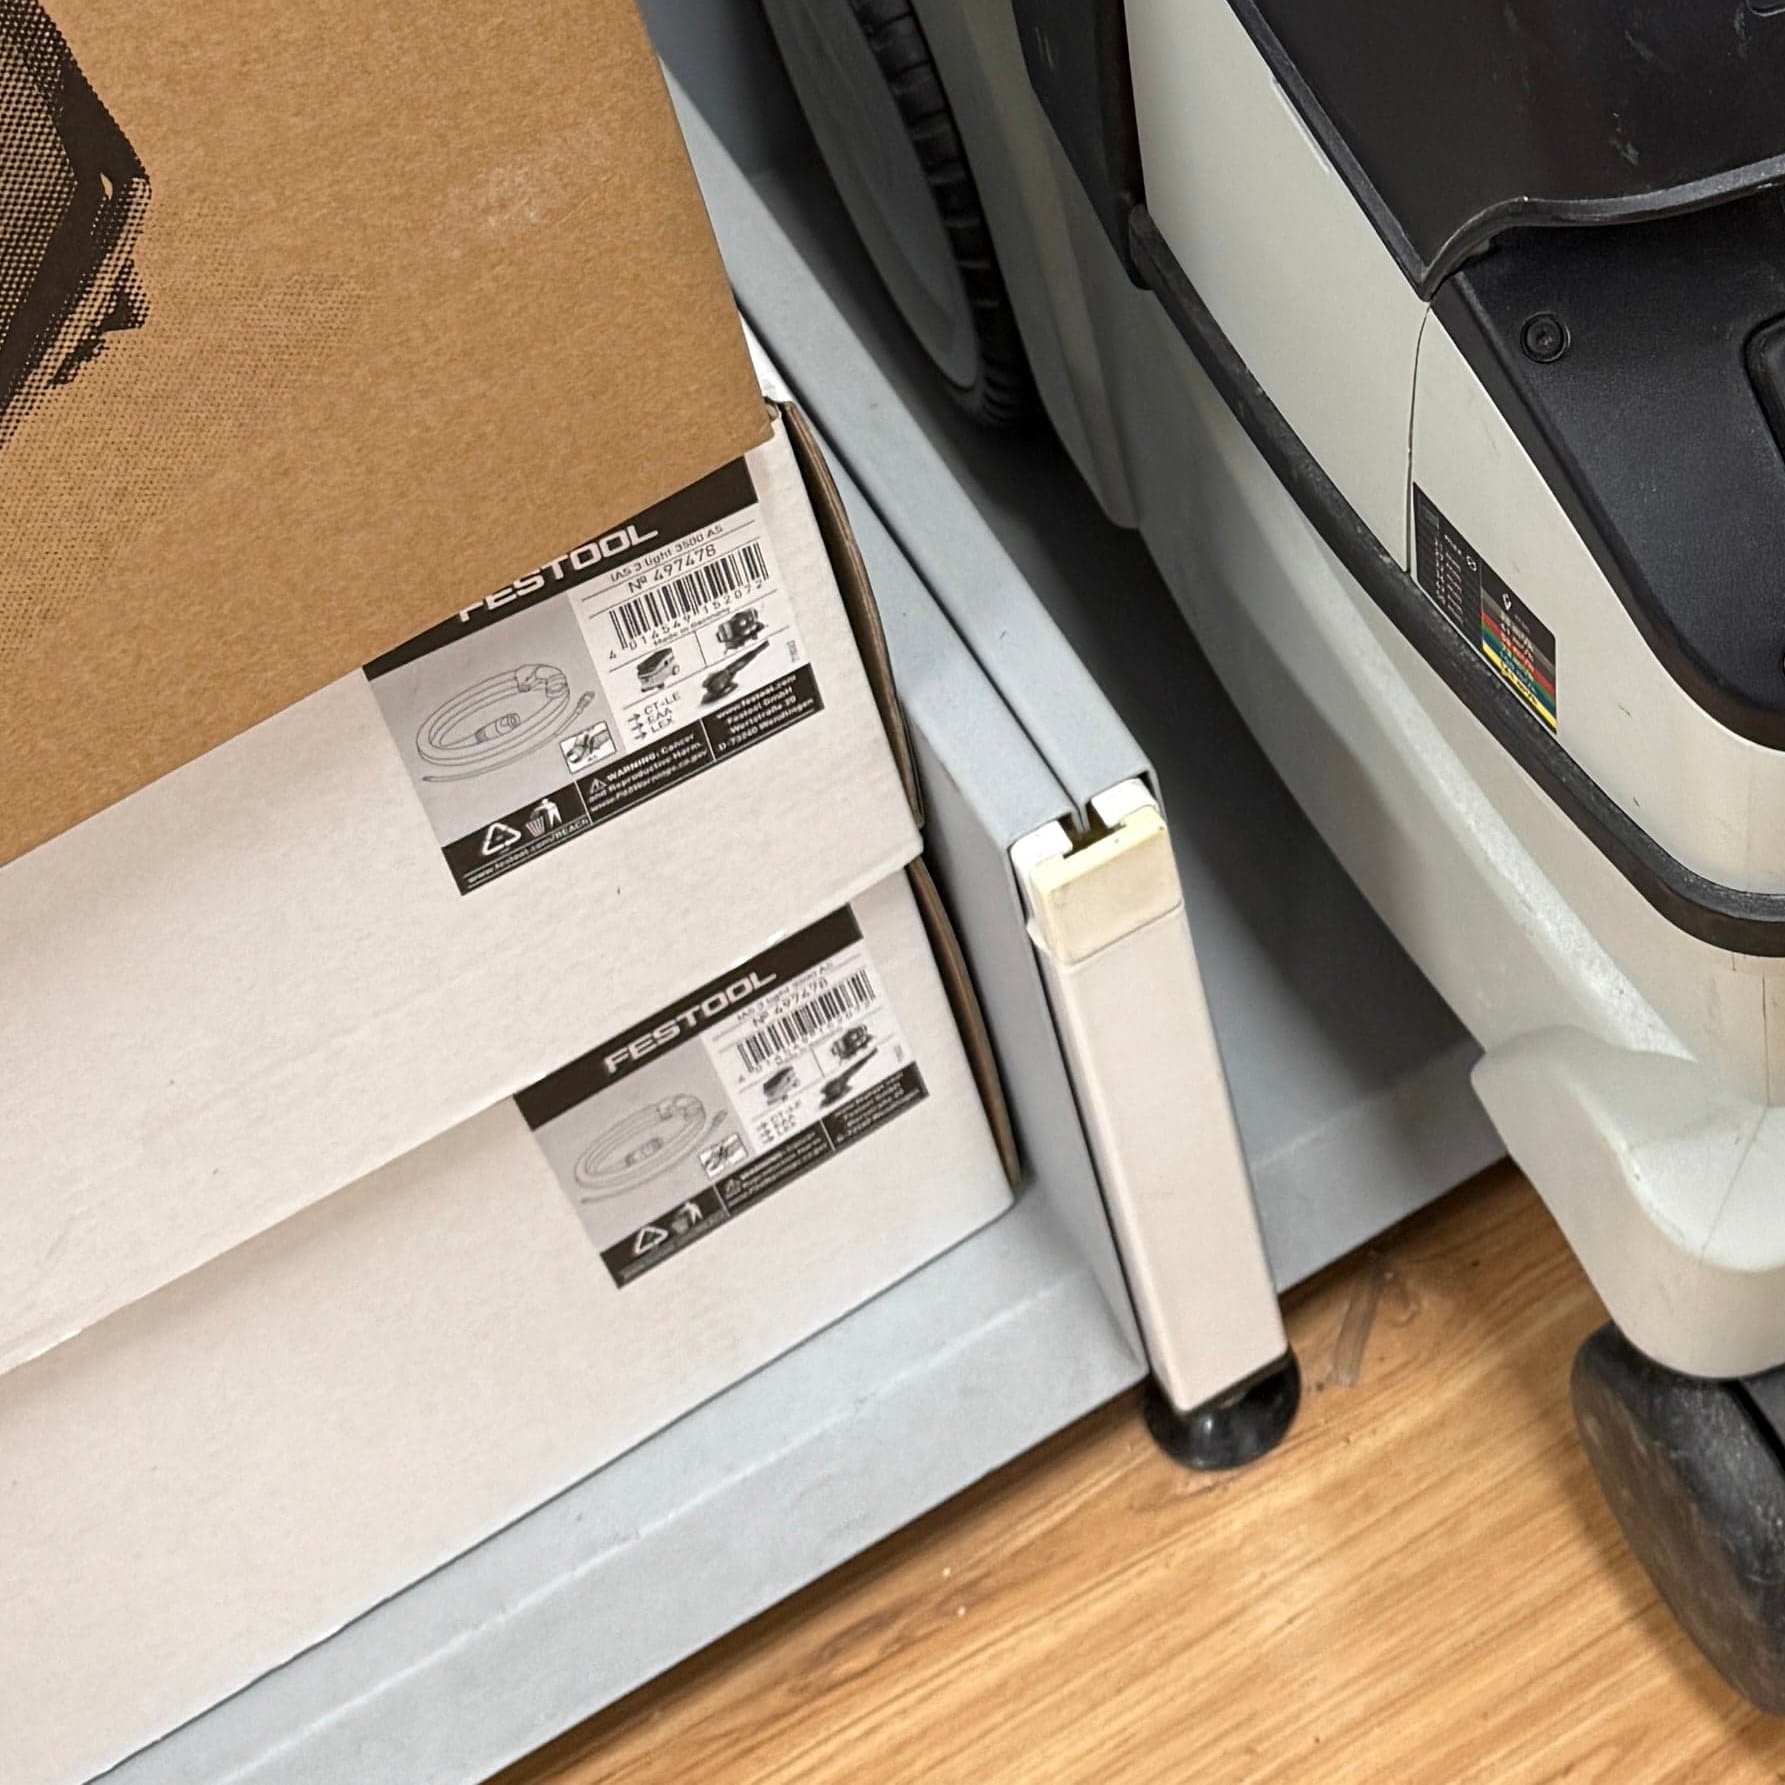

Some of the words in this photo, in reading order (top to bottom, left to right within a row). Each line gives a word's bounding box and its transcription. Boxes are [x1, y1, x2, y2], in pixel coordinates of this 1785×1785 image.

[653, 543, 717, 583] 497478
[650, 717, 675, 733] LEX
[602, 970, 778, 1074] FESTOOL
